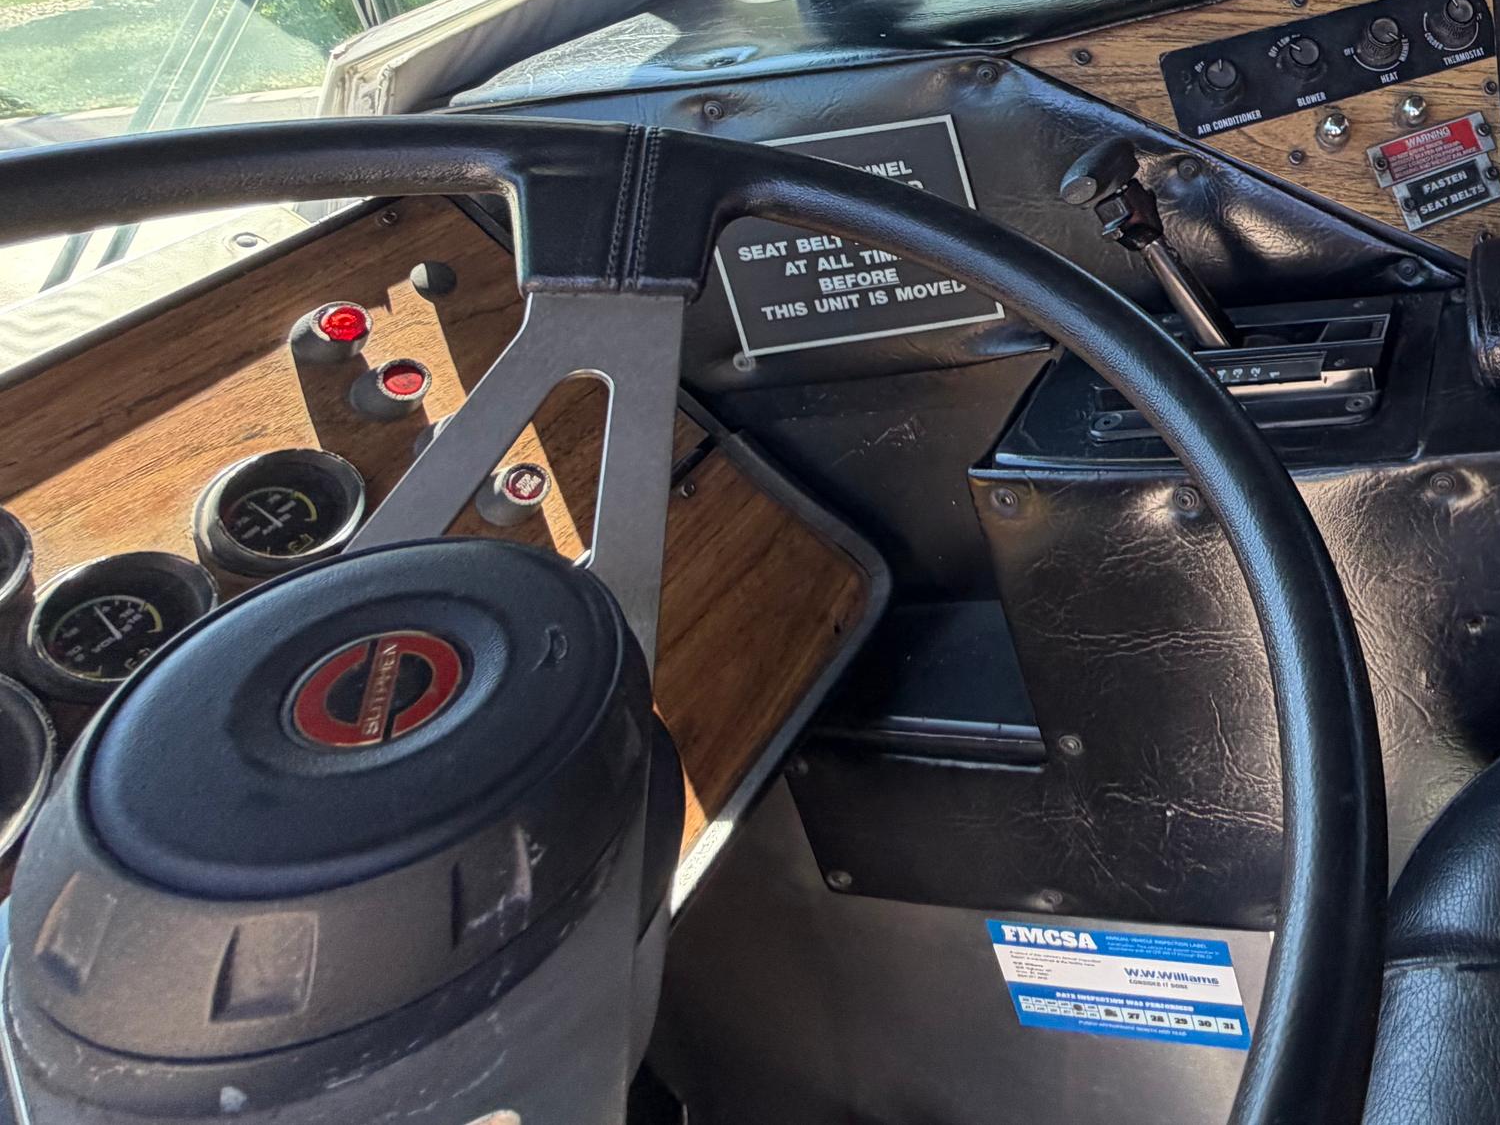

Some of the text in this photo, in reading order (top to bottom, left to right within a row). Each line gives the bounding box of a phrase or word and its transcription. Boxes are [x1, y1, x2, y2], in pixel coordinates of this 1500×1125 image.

[1443, 47, 1485, 66] THERMOSTAT
[1380, 71, 1399, 84] HEAT
[1296, 91, 1327, 107] BLOWER
[1197, 110, 1262, 135] AIR CONDITIONER
[1406, 126, 1451, 148] WARNING
[1422, 170, 1468, 195] FASTEN
[1420, 183, 1486, 215] SEAT BELTS
[738, 240, 789, 262] SEAT
[784, 249, 903, 278] AT ALL TIM
[819, 268, 899, 293] BEFORE
[761, 279, 967, 321] THIS UNIT IS MOVED
[1000, 923, 1098, 951] FMCSA
[1127, 1012, 1140, 1020] 27
[1150, 1015, 1165, 1023] 28
[1174, 1017, 1188, 1026] 29
[1197, 1019, 1212, 1028] 30
[1223, 1022, 1235, 1030] 31
